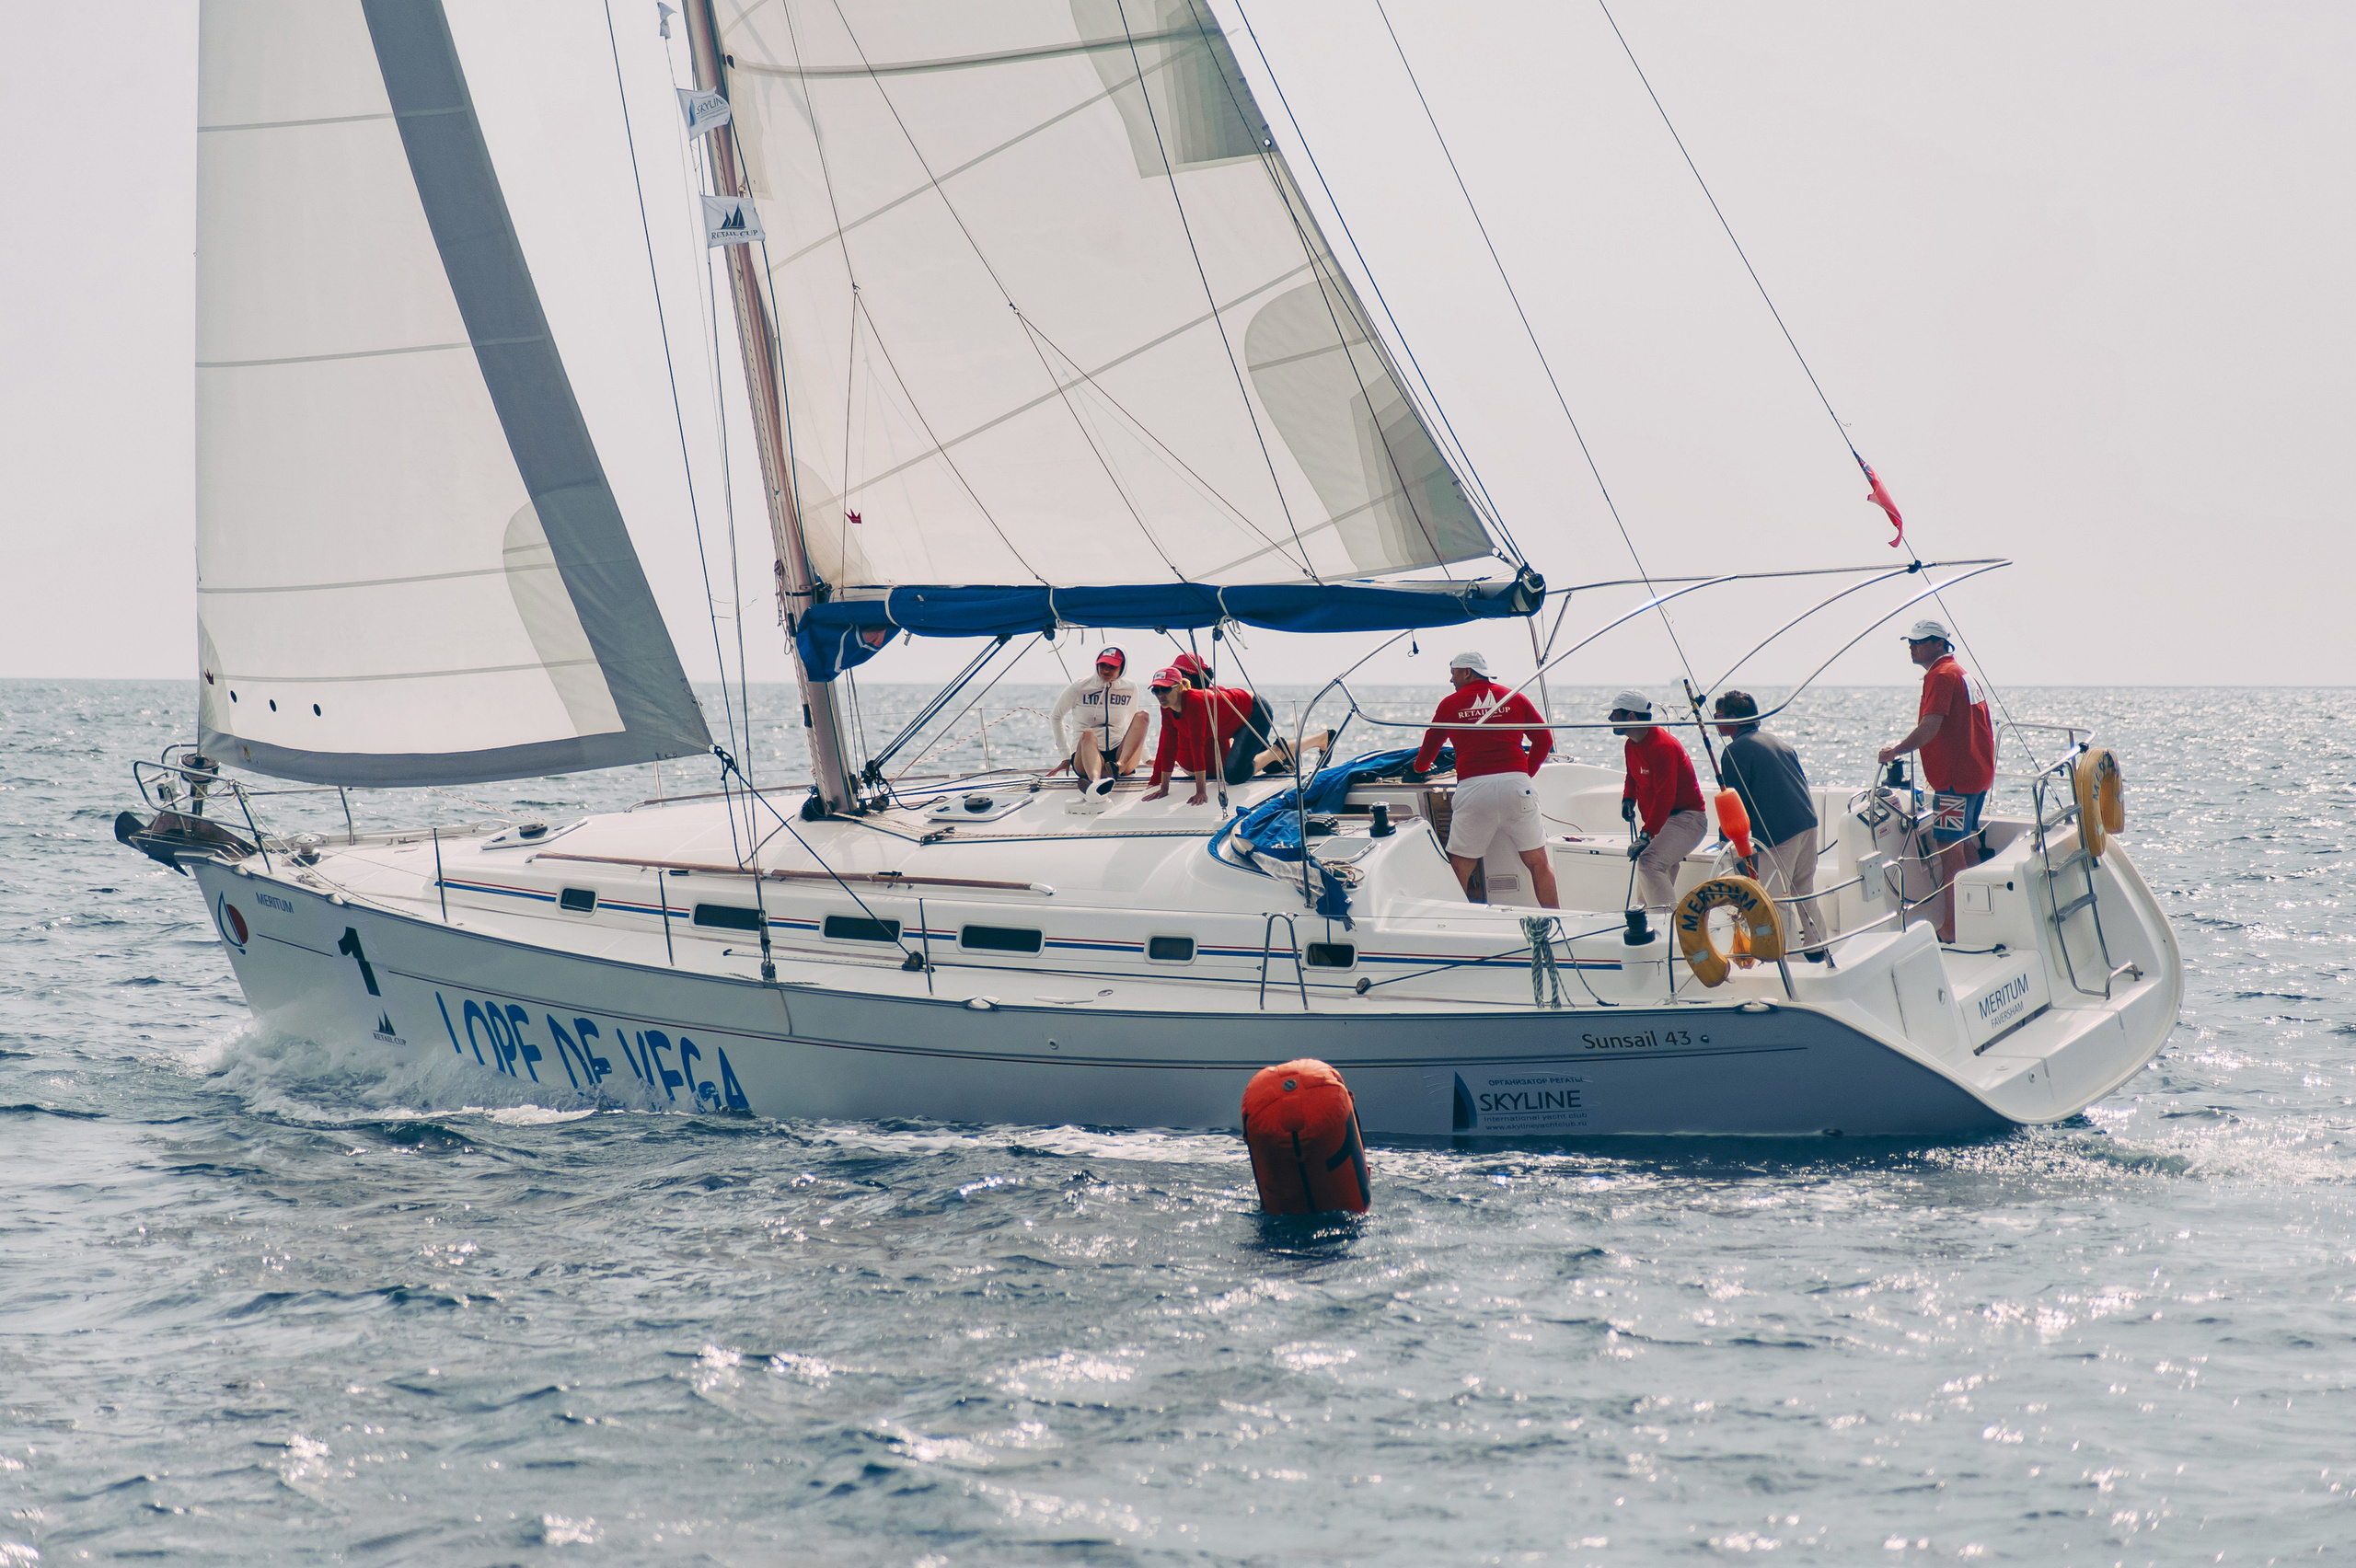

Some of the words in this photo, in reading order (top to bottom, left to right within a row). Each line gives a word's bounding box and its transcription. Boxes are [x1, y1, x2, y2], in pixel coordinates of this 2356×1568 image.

[711, 231, 739, 239] RETAIL
[740, 229, 758, 237] CUP
[1110, 694, 1132, 706] ED97
[256, 892, 294, 915] MERITUM
[1681, 882, 1758, 932] MERITUM
[338, 927, 381, 997] 1
[1979, 973, 2029, 1020] MERITUM
[1991, 1000, 2025, 1029] FAVERSHAM
[372, 1032, 395, 1044] RETAIL
[394, 1037, 407, 1046] CUP
[1581, 1031, 1657, 1049] Sunsail
[1665, 1031, 1692, 1046] 43
[1488, 1078, 1548, 1087] ОРГАНИЗАТОР
[1479, 1090, 1582, 1112] SKYLINE
[1542, 1113, 1566, 1122] yacht
